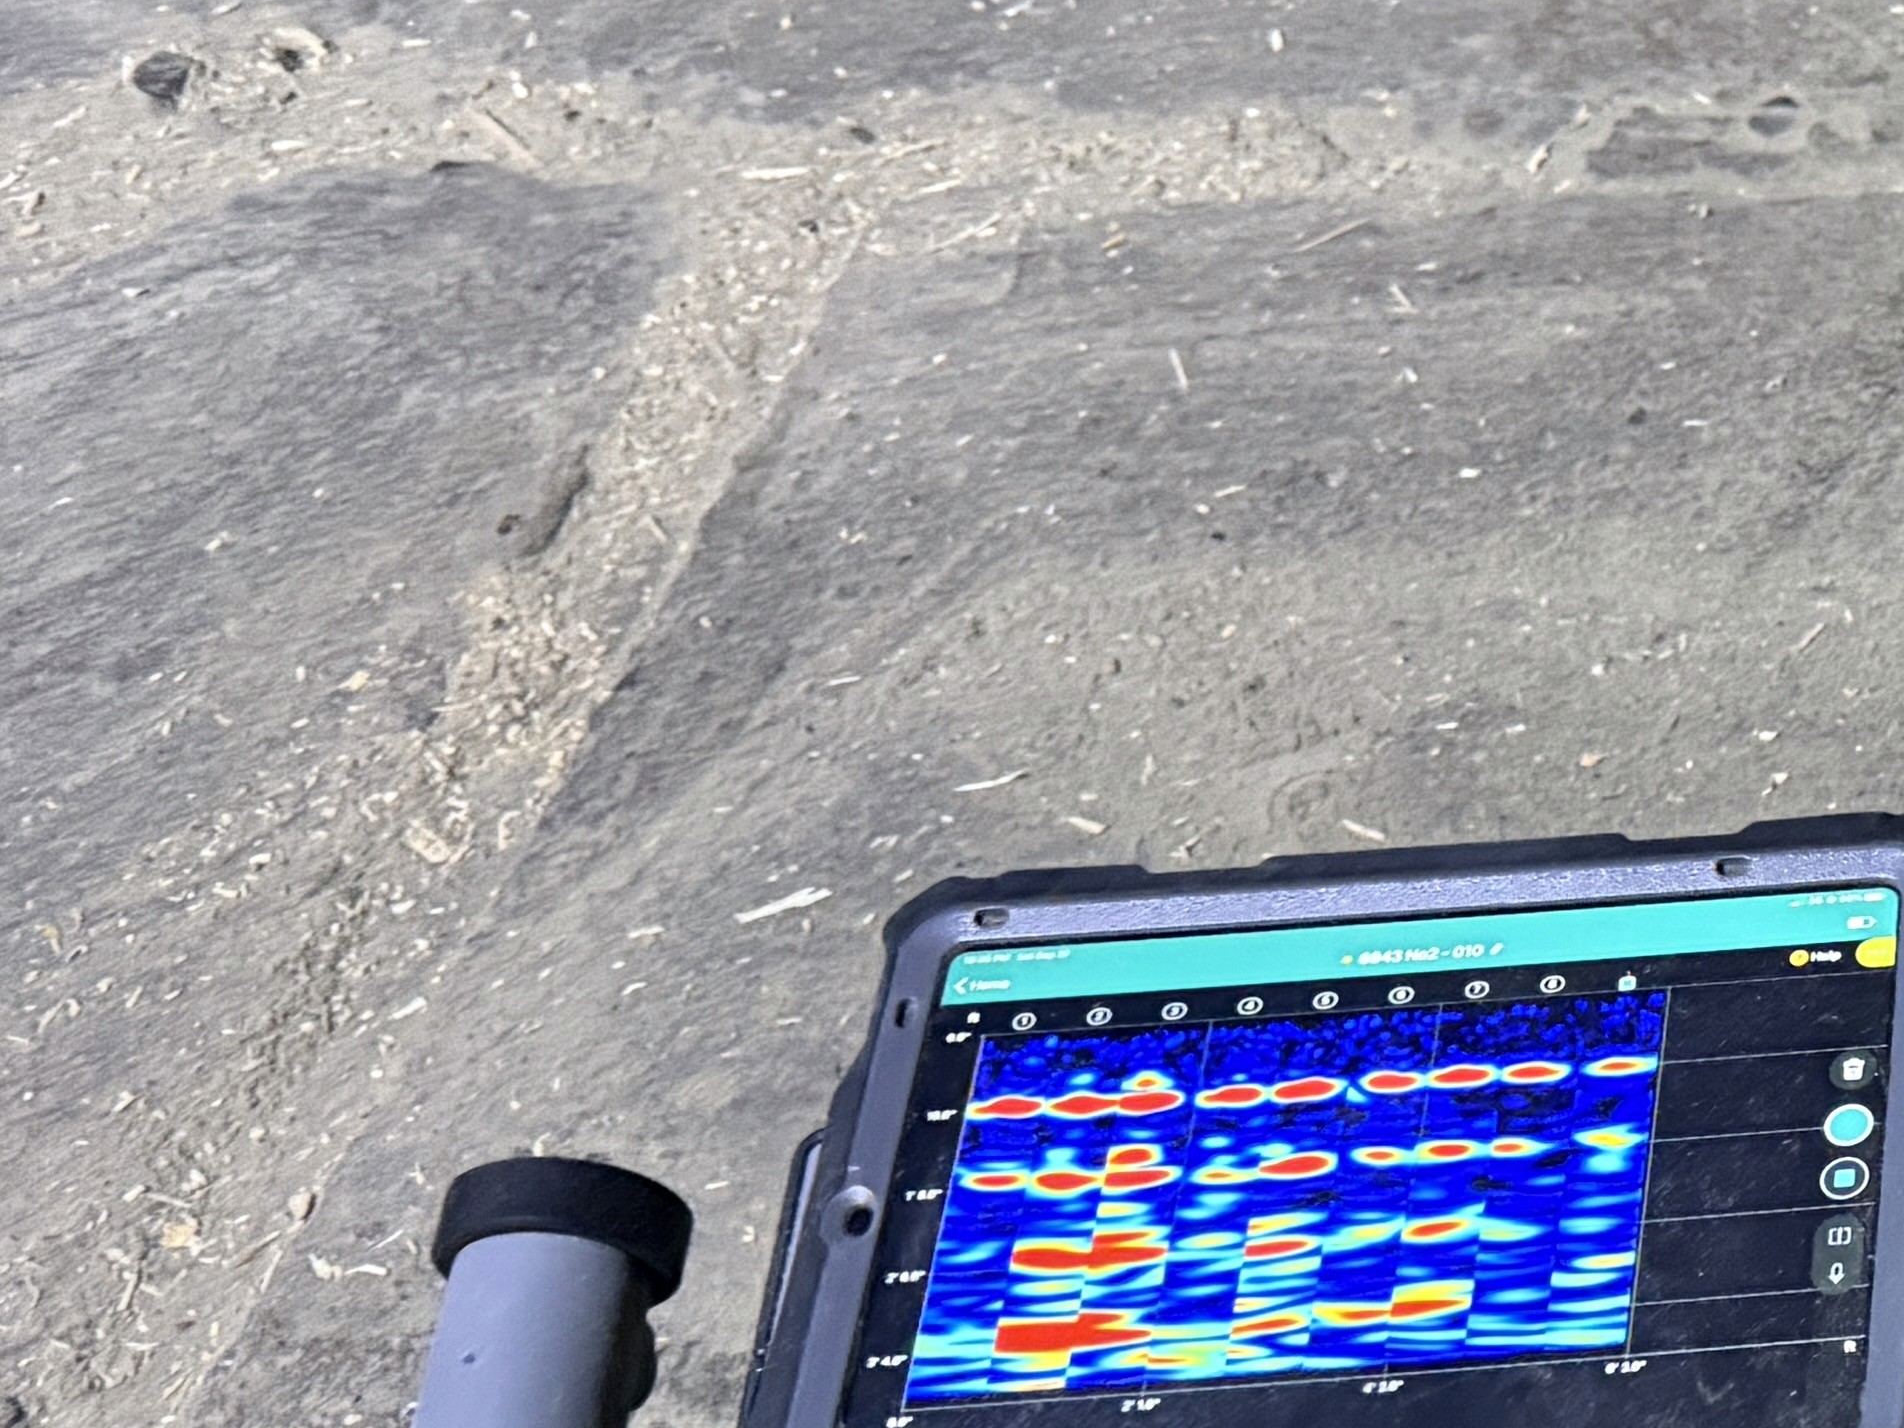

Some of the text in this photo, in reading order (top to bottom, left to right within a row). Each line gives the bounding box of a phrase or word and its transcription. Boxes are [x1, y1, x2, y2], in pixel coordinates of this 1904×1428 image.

[1452, 943, 1485, 959] 010
[1810, 950, 1842, 962] Help
[969, 979, 1011, 992] Home
